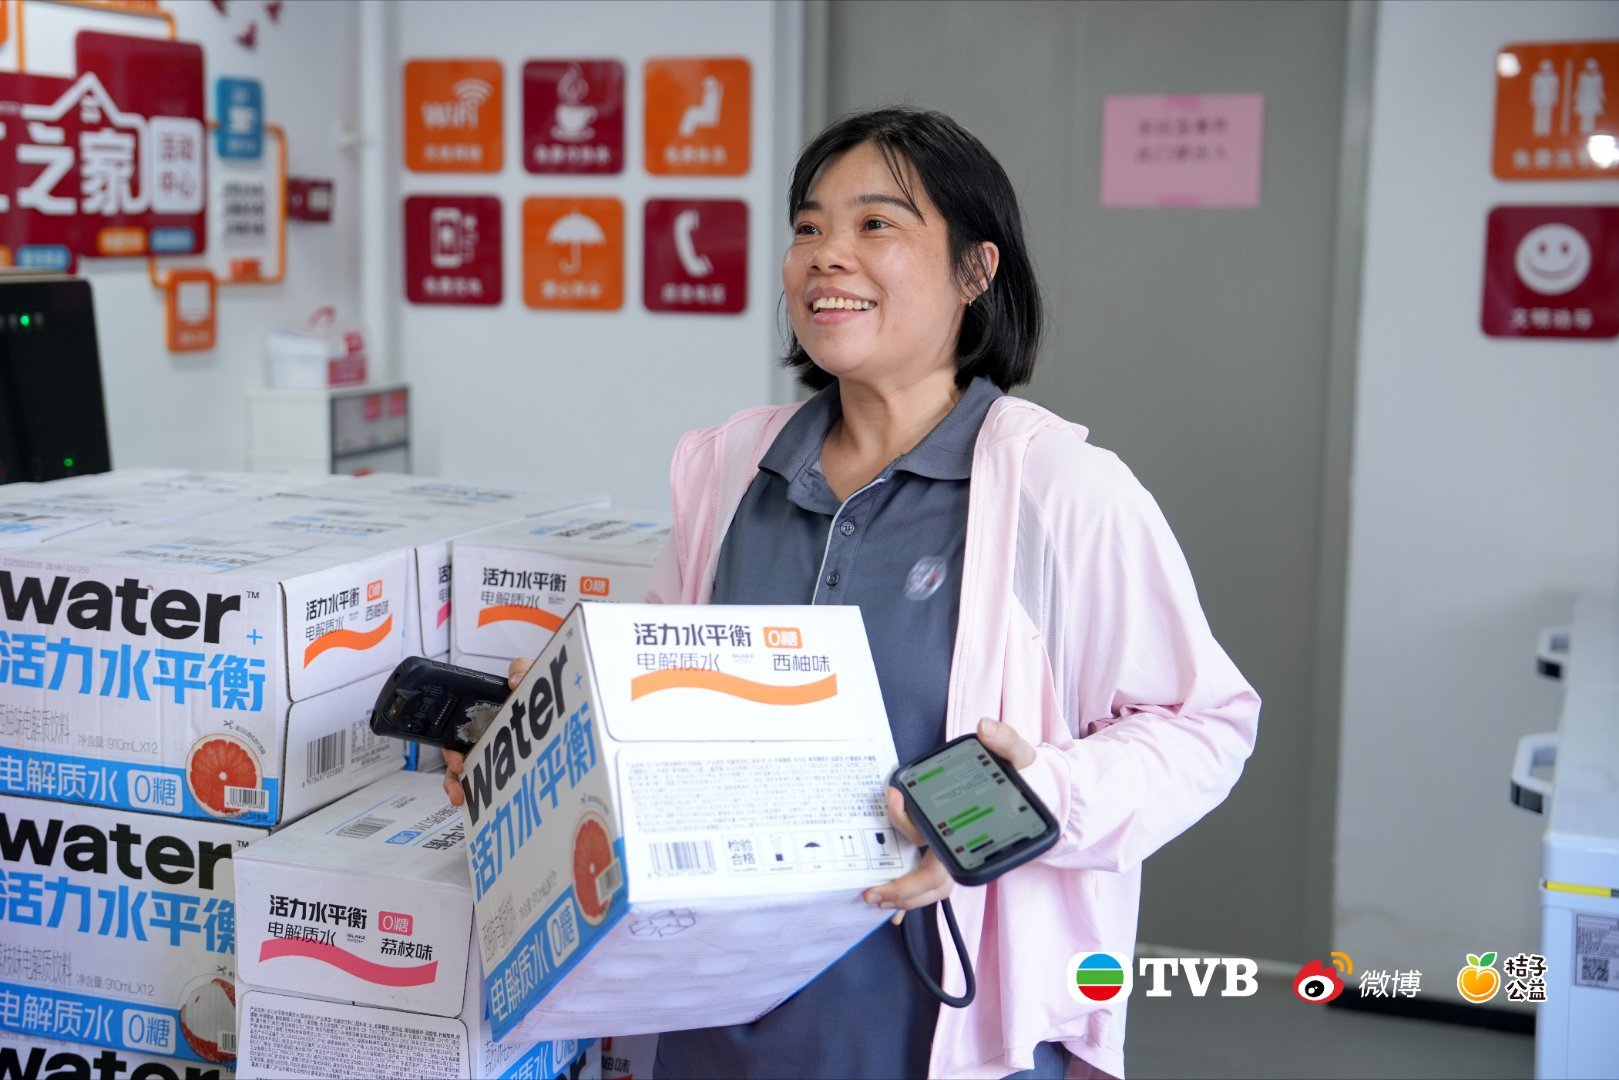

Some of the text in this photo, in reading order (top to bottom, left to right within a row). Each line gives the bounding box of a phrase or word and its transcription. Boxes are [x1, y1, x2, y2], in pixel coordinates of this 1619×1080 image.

[0, 118, 148, 216] 之家
[483, 567, 566, 592] 活力水平衡
[0, 571, 241, 644] water
[306, 587, 360, 621] 活力水平衡
[633, 623, 752, 647] 活力水平衡
[767, 629, 798, 647] 0糖
[0, 630, 266, 712] 活力水平衡
[637, 652, 721, 672] 电解质水
[772, 654, 831, 672] 西柚味
[462, 643, 568, 827] water
[0, 755, 118, 803] 电解质水
[134, 774, 177, 807] 0糖
[470, 703, 597, 903] 活力水平衡
[0, 812, 232, 890] water
[731, 853, 756, 866] 合格
[269, 895, 367, 930] 活力水平衡
[382, 916, 409, 933] 0糖
[267, 921, 336, 947] 电解质水
[380, 937, 433, 962] 荔枝味
[490, 930, 550, 1022] 电解质水
[0, 990, 114, 1042] 电解质水
[129, 1013, 171, 1049] 0糖
